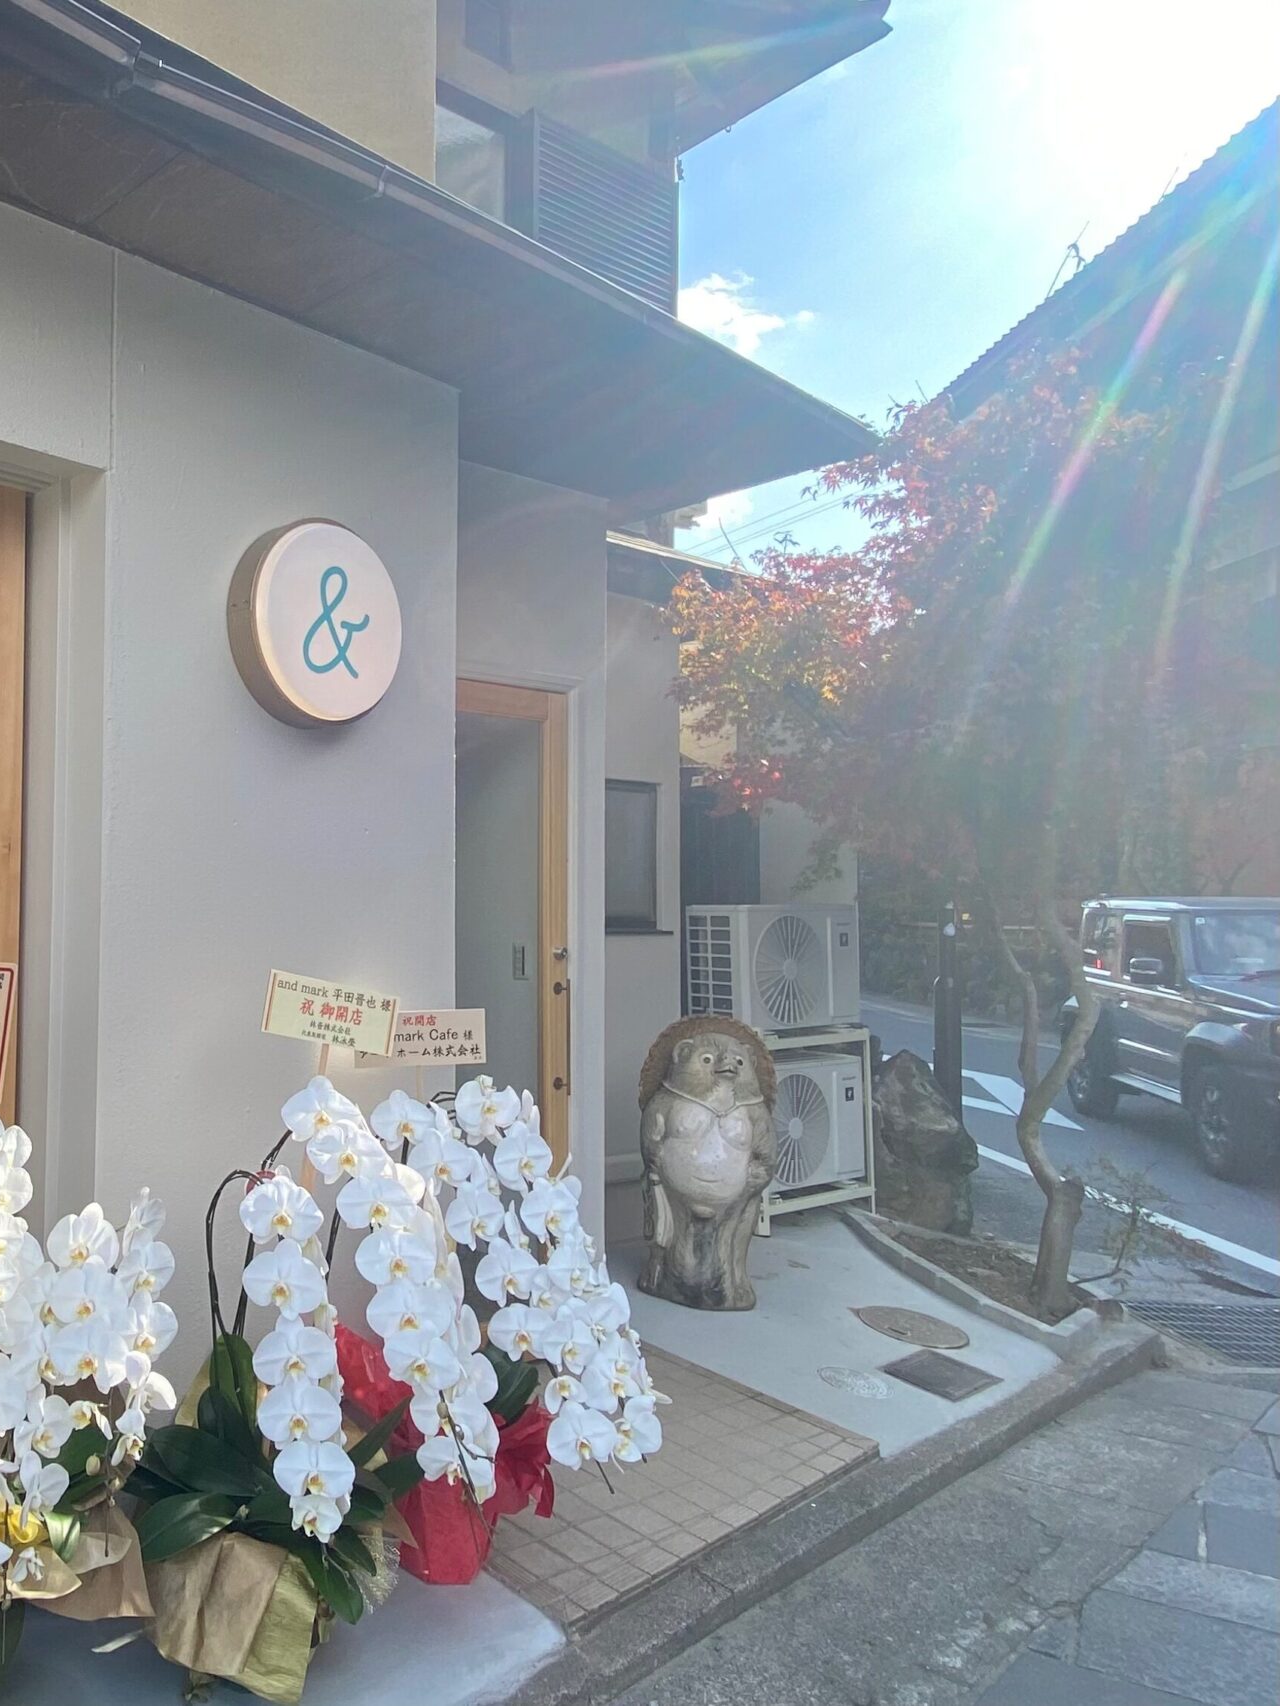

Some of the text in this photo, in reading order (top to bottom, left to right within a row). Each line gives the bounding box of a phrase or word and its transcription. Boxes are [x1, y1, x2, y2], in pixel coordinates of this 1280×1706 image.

[303, 566, 370, 679] &
[277, 980, 299, 992] and
[300, 984, 330, 999] mark
[299, 997, 364, 1026] 祝 御開店
[402, 1014, 438, 1027] 祝開店
[393, 1029, 425, 1042] mark
[429, 1028, 459, 1041] Cafe
